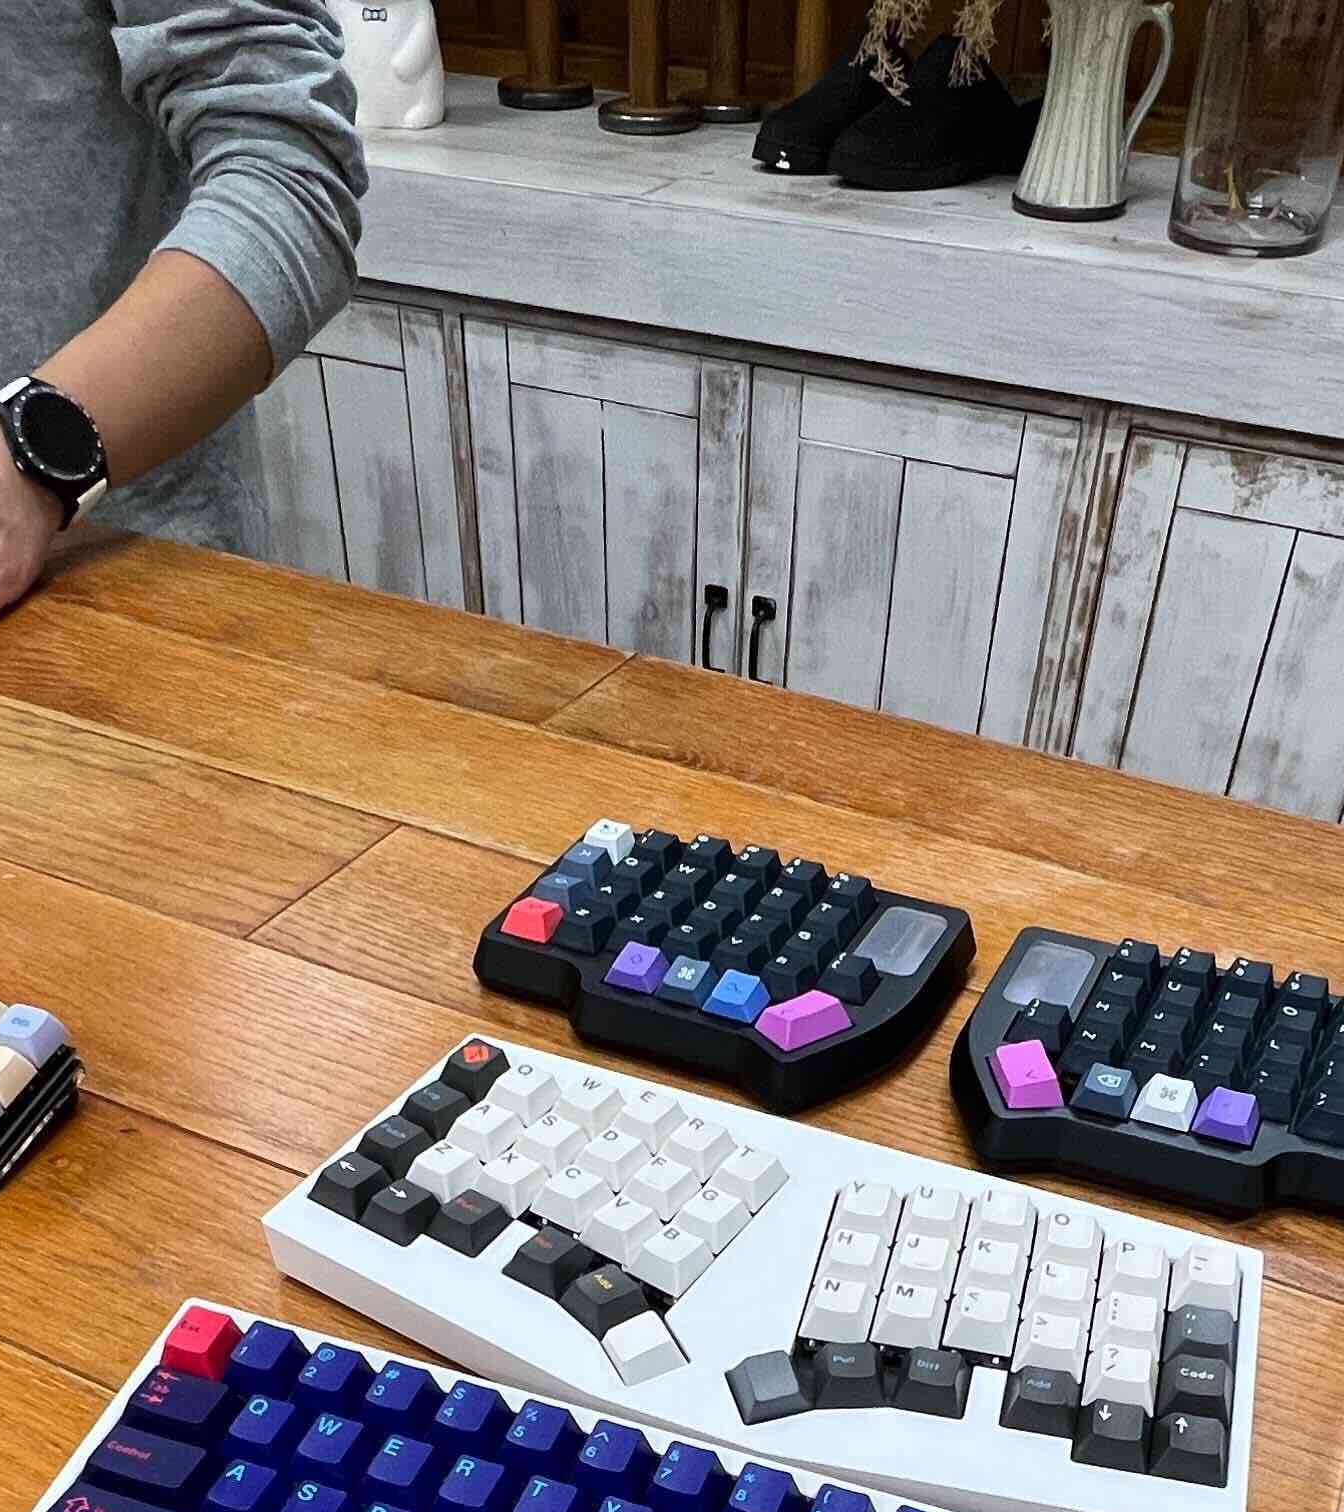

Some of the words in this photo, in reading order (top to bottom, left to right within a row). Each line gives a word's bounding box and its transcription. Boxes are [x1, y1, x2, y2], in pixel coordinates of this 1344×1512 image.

[1111, 971, 1124, 982] Y
[1212, 1022, 1225, 1033] K
[582, 1075, 602, 1091] W
[639, 1090, 657, 1103] E
[475, 1104, 492, 1116] A
[541, 1114, 558, 1127] S
[688, 1117, 705, 1130] R
[603, 1130, 619, 1142] D
[434, 1143, 453, 1155] Z
[741, 1145, 755, 1157] T
[501, 1152, 518, 1164] X
[651, 1157, 668, 1169] F
[565, 1167, 582, 1179] C
[853, 1181, 865, 1193] Y
[920, 1185, 934, 1199] U
[702, 1190, 720, 1201] G
[615, 1197, 631, 1208] V
[663, 1227, 681, 1240] B
[837, 1232, 853, 1246] H
[907, 1237, 920, 1249] J
[977, 1240, 993, 1253] K
[1122, 1242, 1135, 1253] P
[1045, 1264, 1057, 1277] L
[824, 1279, 841, 1292] N
[896, 1285, 915, 1298] M
[318, 1348, 335, 1362] @
[305, 1366, 317, 1377] 2
[385, 1367, 400, 1380] #
[1179, 1367, 1215, 1381] Code
[374, 1385, 385, 1397] 3
[249, 1399, 268, 1415] Q
[443, 1407, 454, 1418] 4
[526, 1408, 539, 1422] %
[317, 1417, 342, 1435] W
[513, 1425, 525, 1438] 5
[594, 1431, 609, 1443] ^
[106, 1440, 152, 1460] Control
[383, 1439, 404, 1457] E
[585, 1446, 596, 1458] 6
[225, 1464, 245, 1482] A
[455, 1459, 474, 1477] R
[660, 1468, 673, 1480] 7
[298, 1483, 317, 1501] S
[532, 1479, 548, 1497] T
[735, 1490, 747, 1501] 8
[823, 1490, 832, 1504] (
